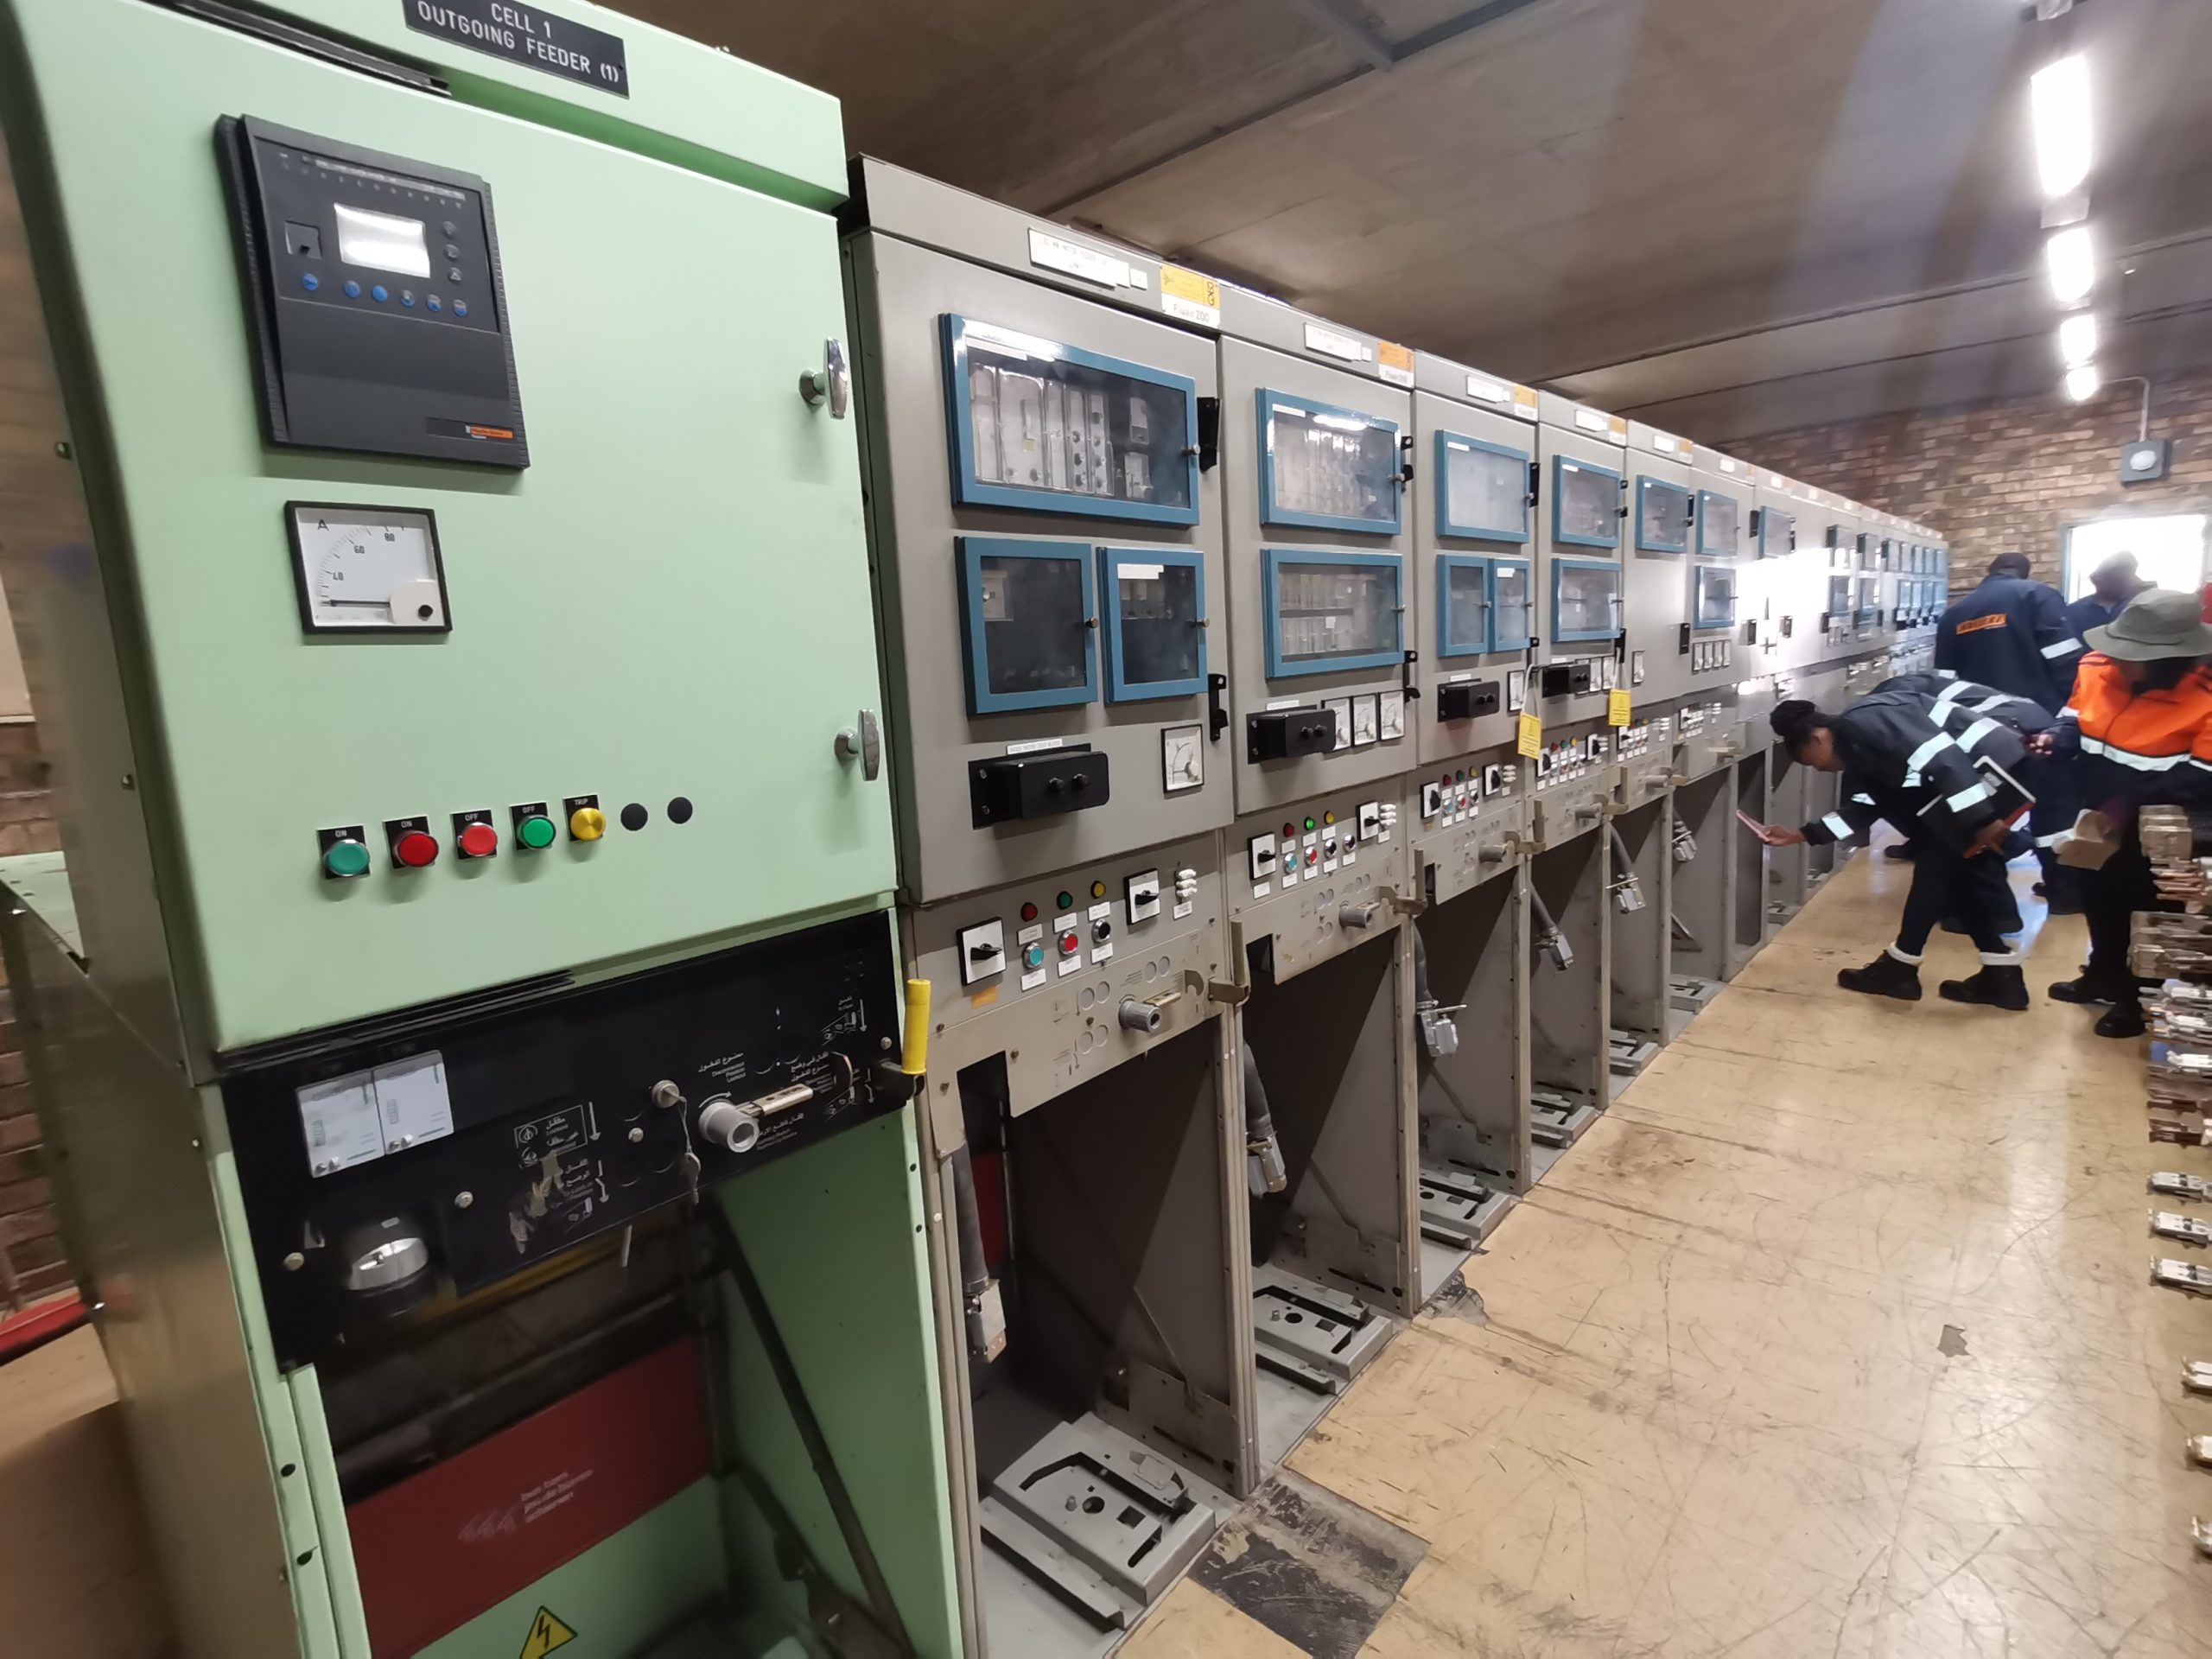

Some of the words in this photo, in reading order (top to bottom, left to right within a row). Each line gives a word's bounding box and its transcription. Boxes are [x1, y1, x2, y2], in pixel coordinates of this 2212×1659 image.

[491, 3, 535, 34] CELL
[543, 21, 551, 39] 1
[417, 1, 516, 49] OUTGOING
[525, 37, 591, 73] FEEDER
[600, 62, 620, 83] (1)
[317, 519, 329, 531] A
[385, 533, 395, 542] 80
[353, 545, 365, 554] 60
[333, 572, 344, 581] 40
[464, 813, 479, 822] OFF
[334, 830, 347, 838] ON
